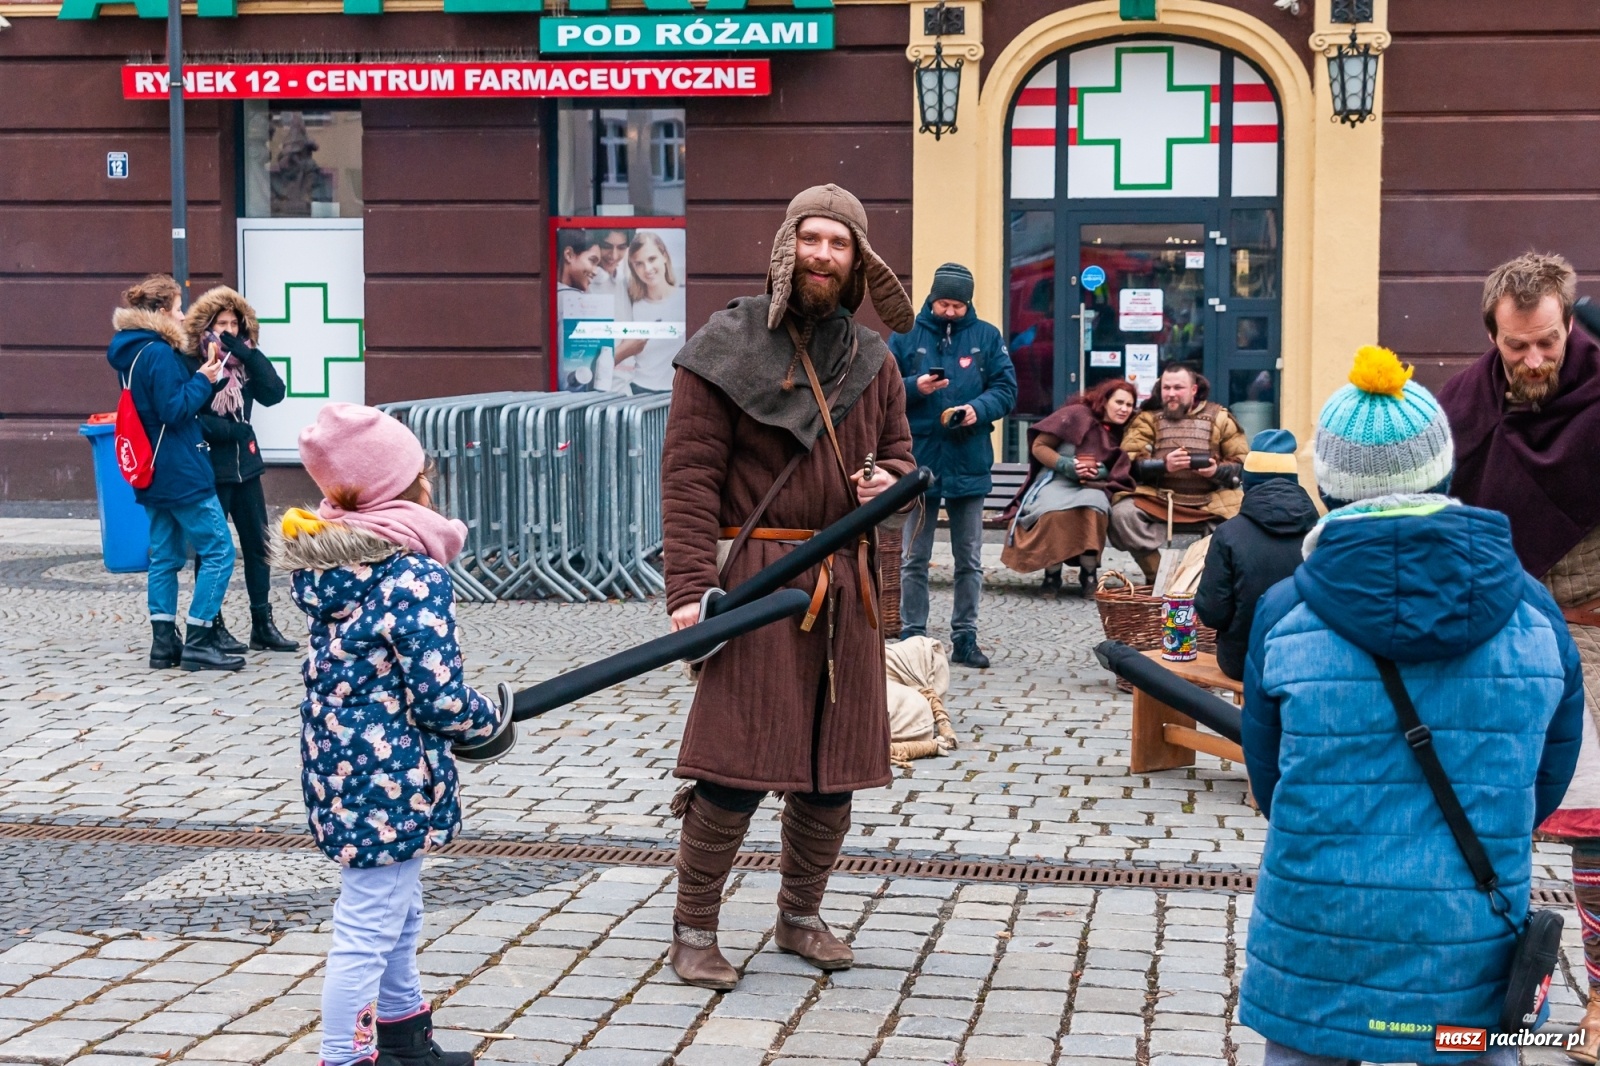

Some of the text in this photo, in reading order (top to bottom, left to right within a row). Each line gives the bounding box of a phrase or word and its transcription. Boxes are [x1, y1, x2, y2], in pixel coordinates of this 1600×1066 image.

[557, 18, 818, 47] POD RÓŻAMI
[245, 71, 281, 93] 12
[306, 69, 455, 92] CENTRUM
[464, 67, 756, 91] FARMACEUTYCZNE
[110, 160, 123, 173] 12
